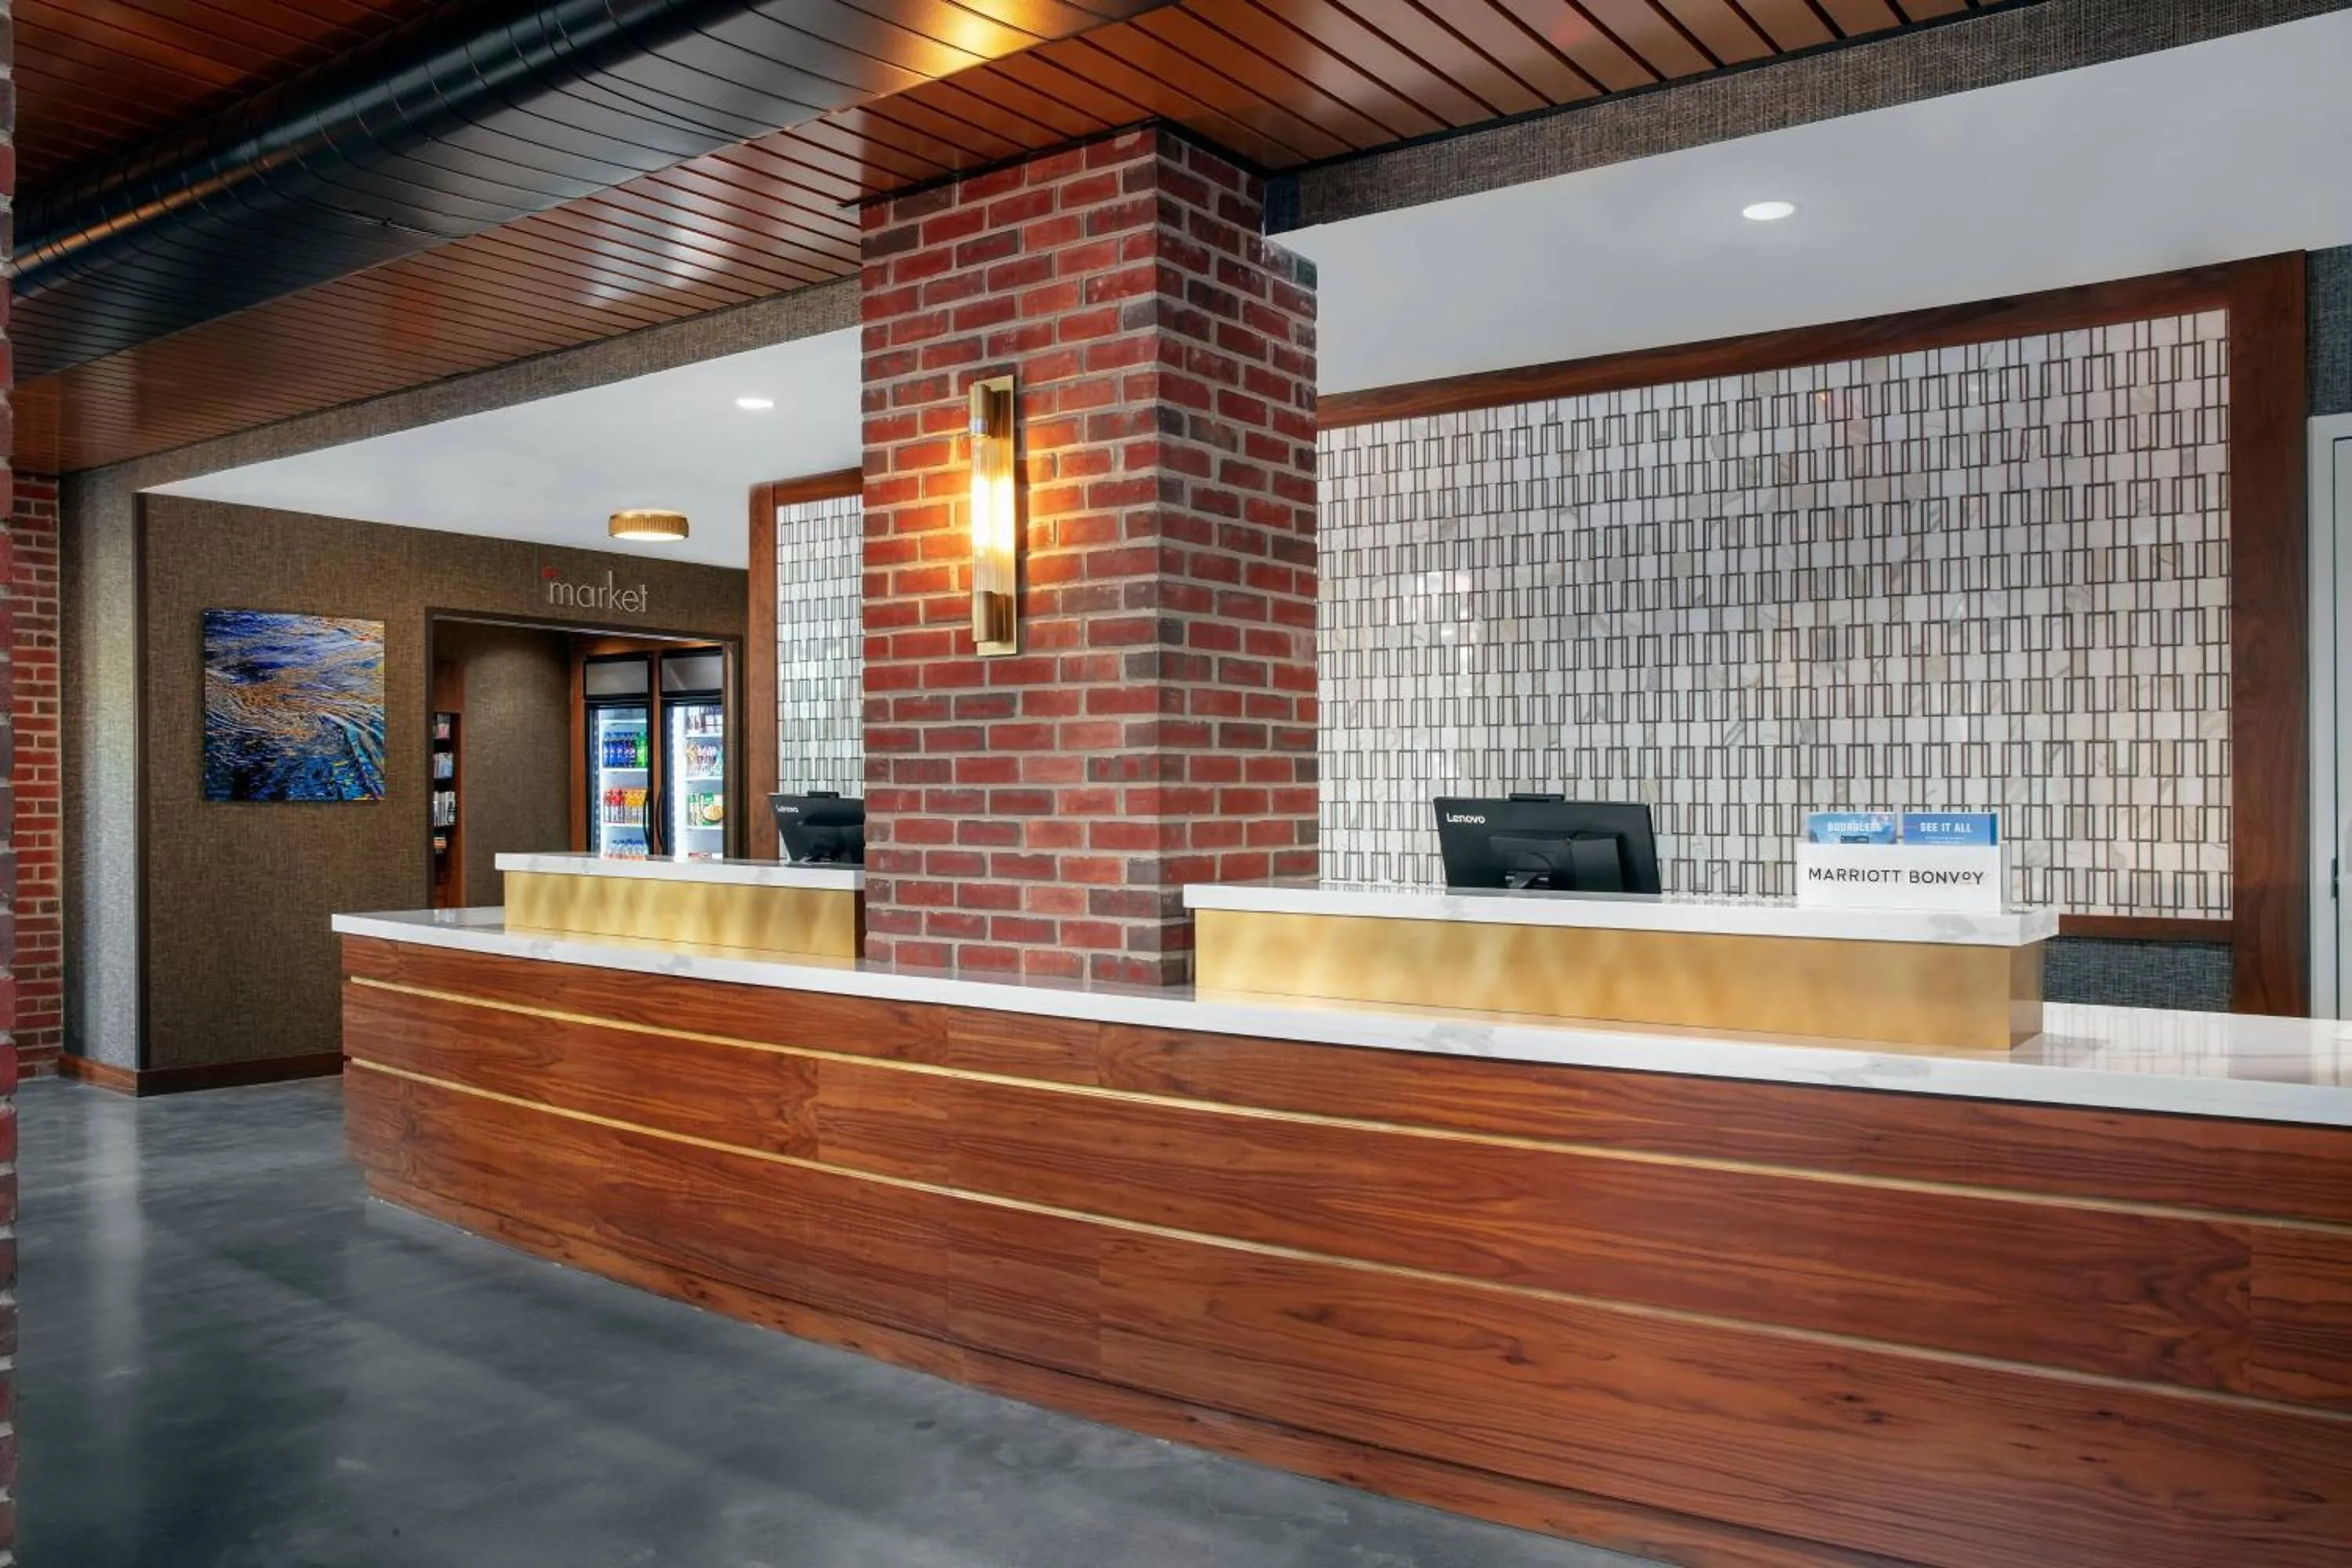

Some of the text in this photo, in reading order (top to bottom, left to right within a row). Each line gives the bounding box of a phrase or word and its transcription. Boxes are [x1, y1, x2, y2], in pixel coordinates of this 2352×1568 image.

[550, 570, 648, 613] market
[1446, 812, 1486, 824] Lenovo
[1920, 822, 1973, 833] SEE IT ALL
[1808, 868, 1902, 884] MARRIOTT
